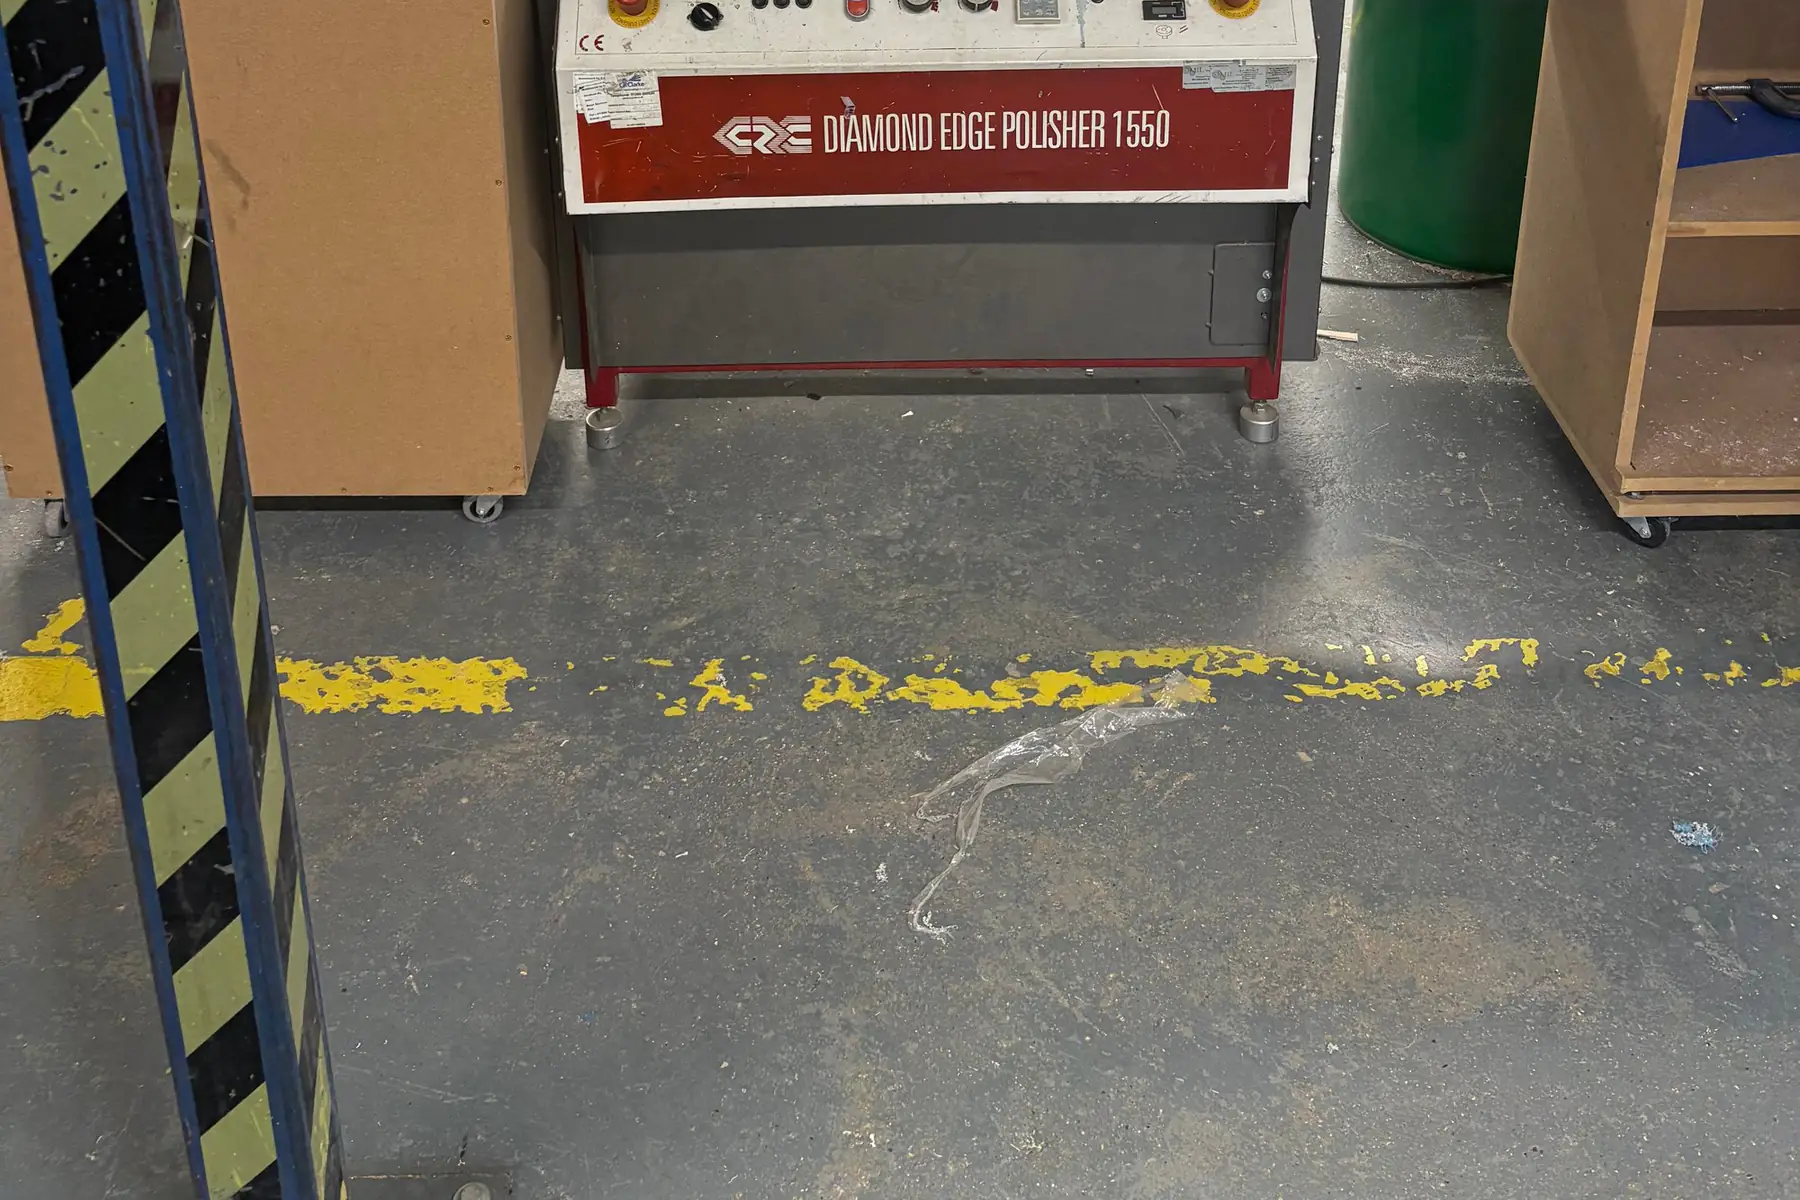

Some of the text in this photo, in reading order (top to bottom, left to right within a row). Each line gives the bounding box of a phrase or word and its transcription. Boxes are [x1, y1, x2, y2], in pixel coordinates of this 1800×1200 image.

[579, 35, 605, 52] CE
[823, 113, 933, 153] DIAMOND
[940, 111, 996, 151] EDGE
[1002, 110, 1105, 150] POLISHER
[1113, 108, 1170, 149] 1550
